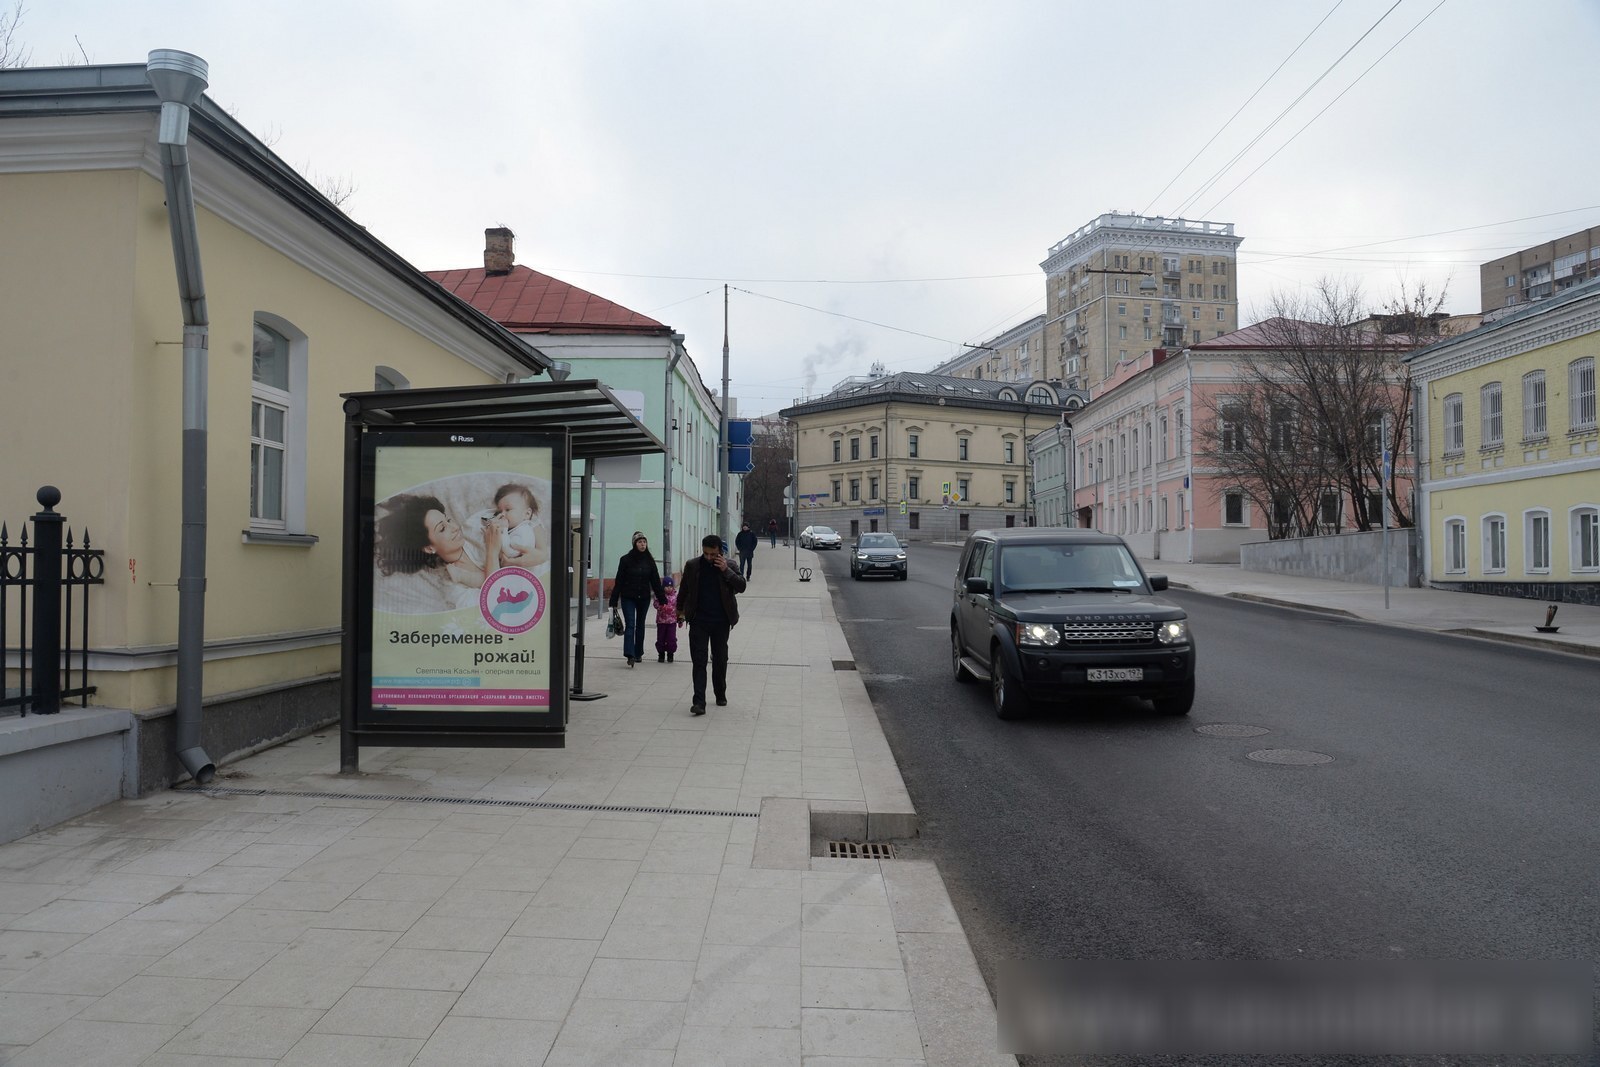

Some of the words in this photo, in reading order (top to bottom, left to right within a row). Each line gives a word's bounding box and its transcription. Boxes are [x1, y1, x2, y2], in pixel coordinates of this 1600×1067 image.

[390, 630, 502, 647] Забеременев
[474, 650, 535, 665] рожай!
[416, 667, 452, 675] Светлана
[453, 667, 480, 675] Касьян
